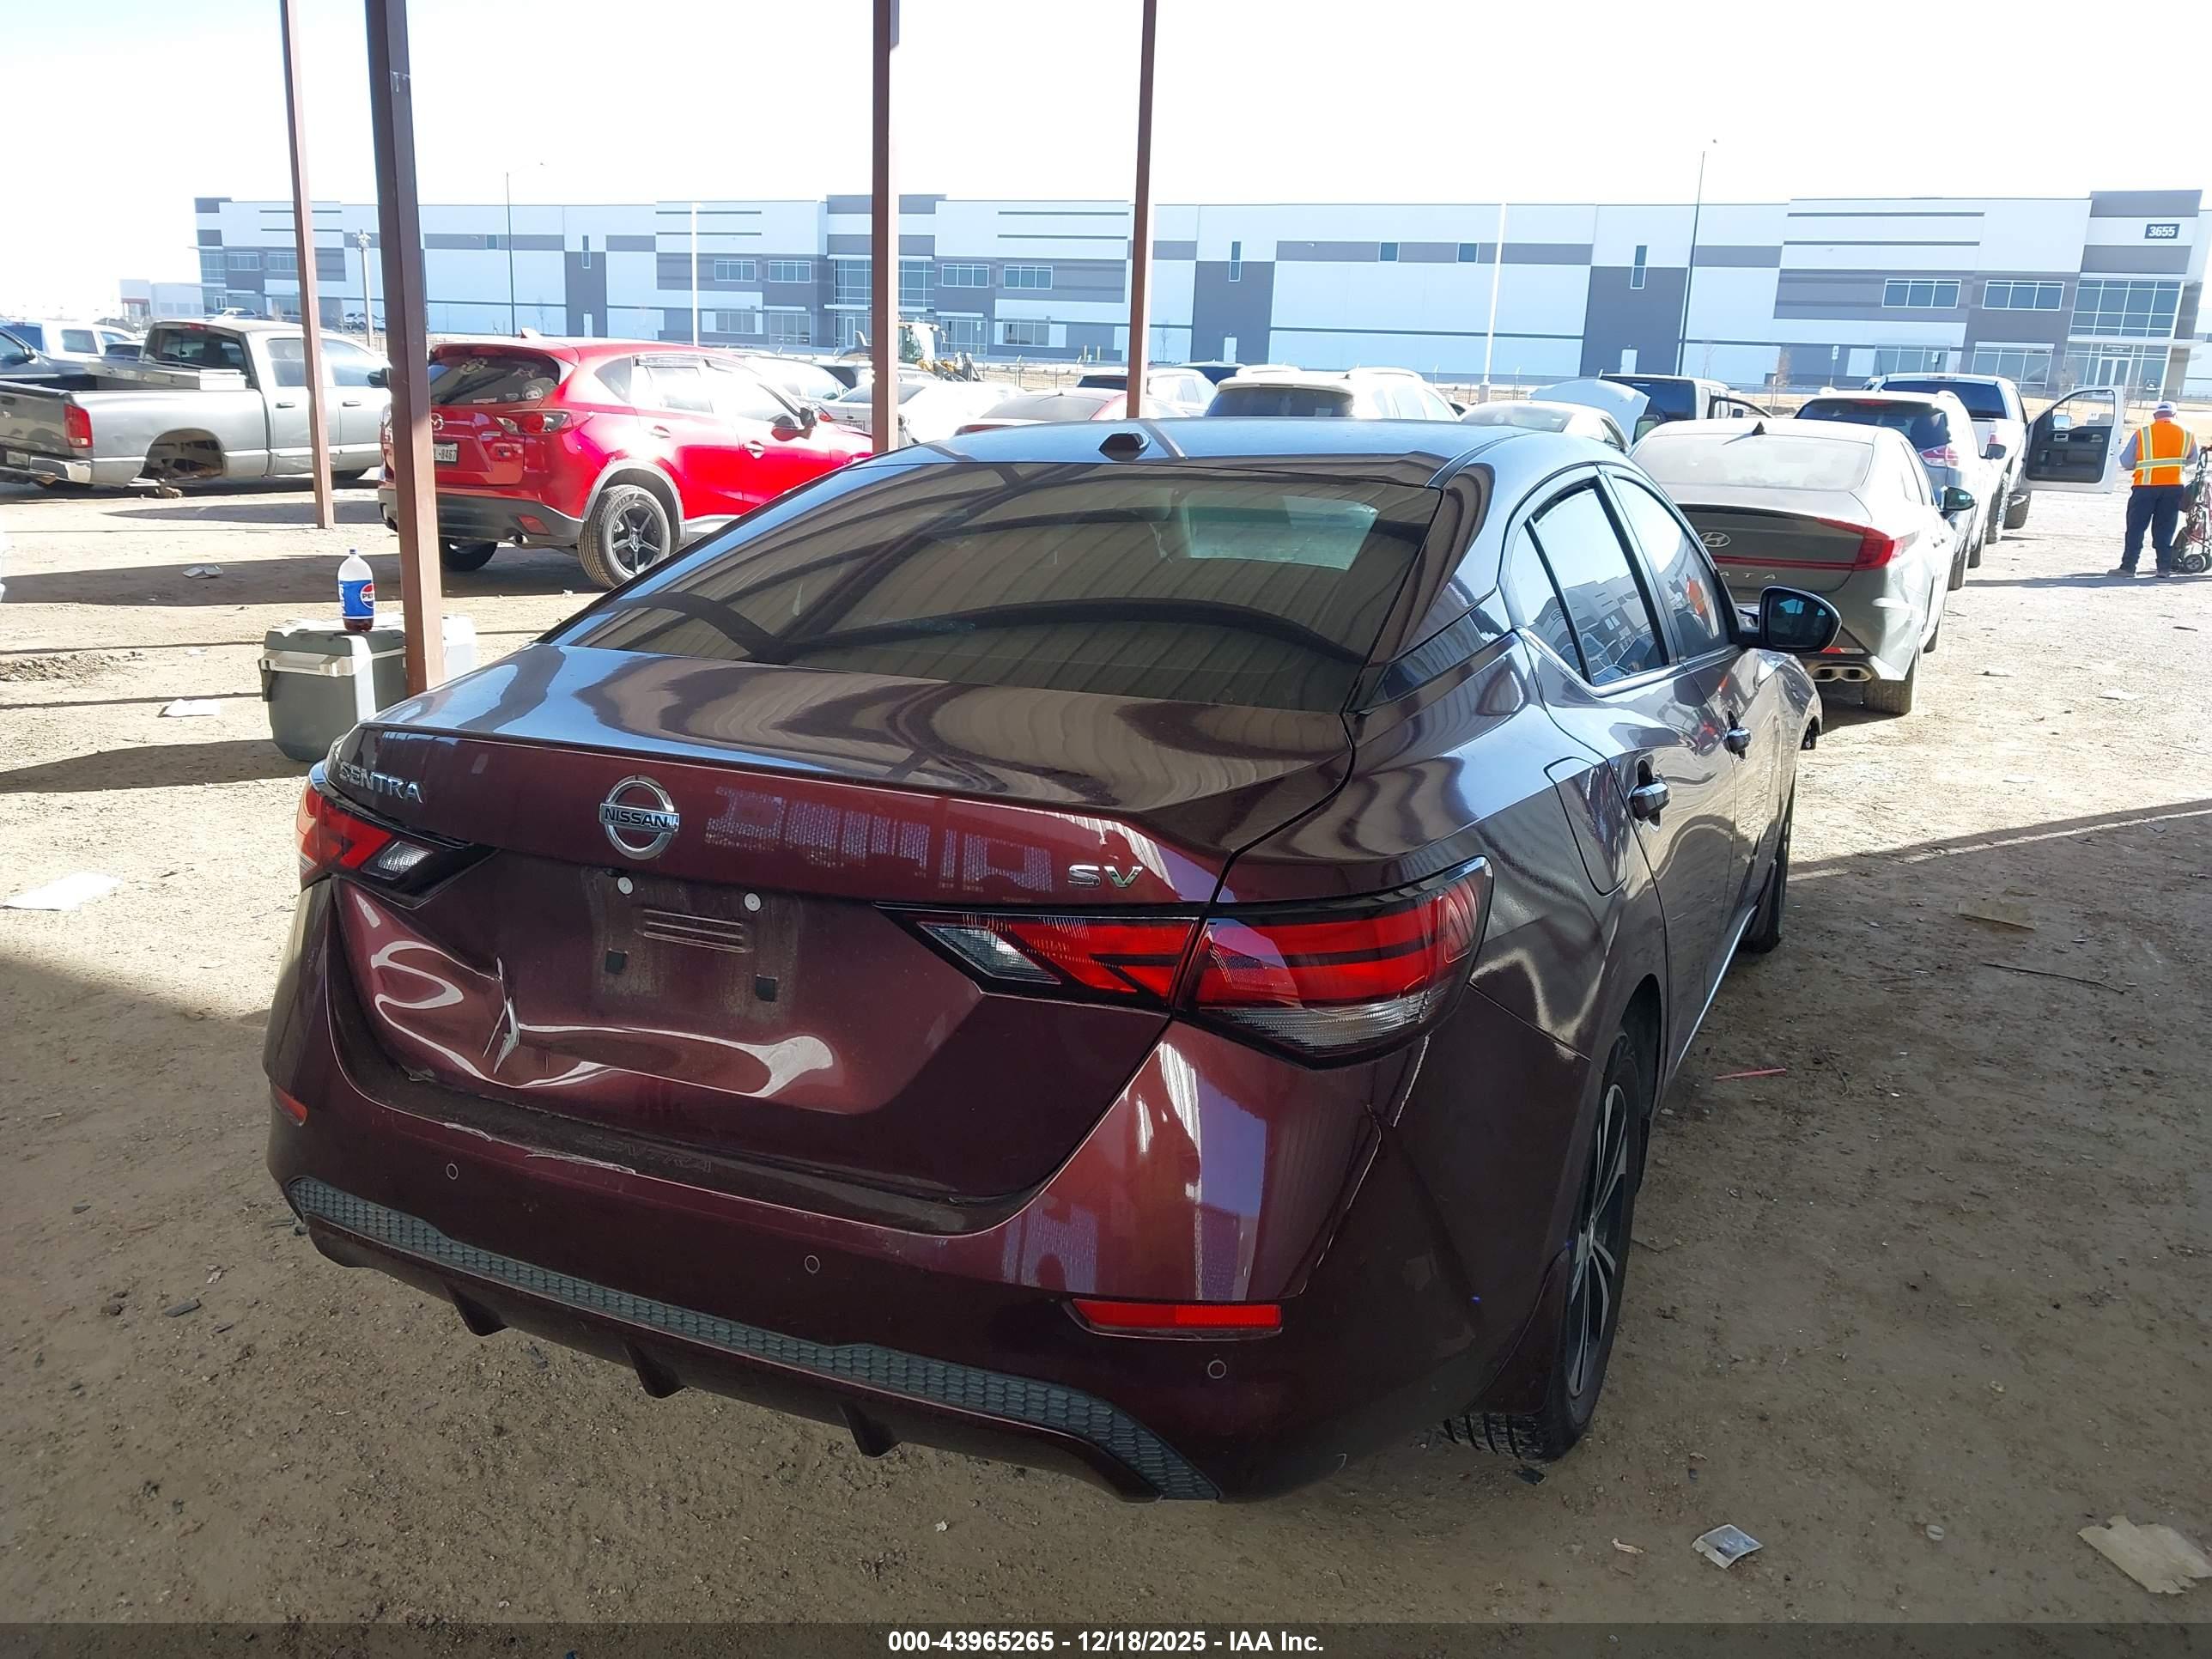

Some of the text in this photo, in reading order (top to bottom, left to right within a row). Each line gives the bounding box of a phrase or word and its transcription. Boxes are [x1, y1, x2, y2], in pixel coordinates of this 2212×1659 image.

[2148, 226, 2176, 237] 3655
[338, 761, 424, 804] SENTRA
[605, 808, 668, 828] NISSAN
[1067, 864, 1144, 888] SV
